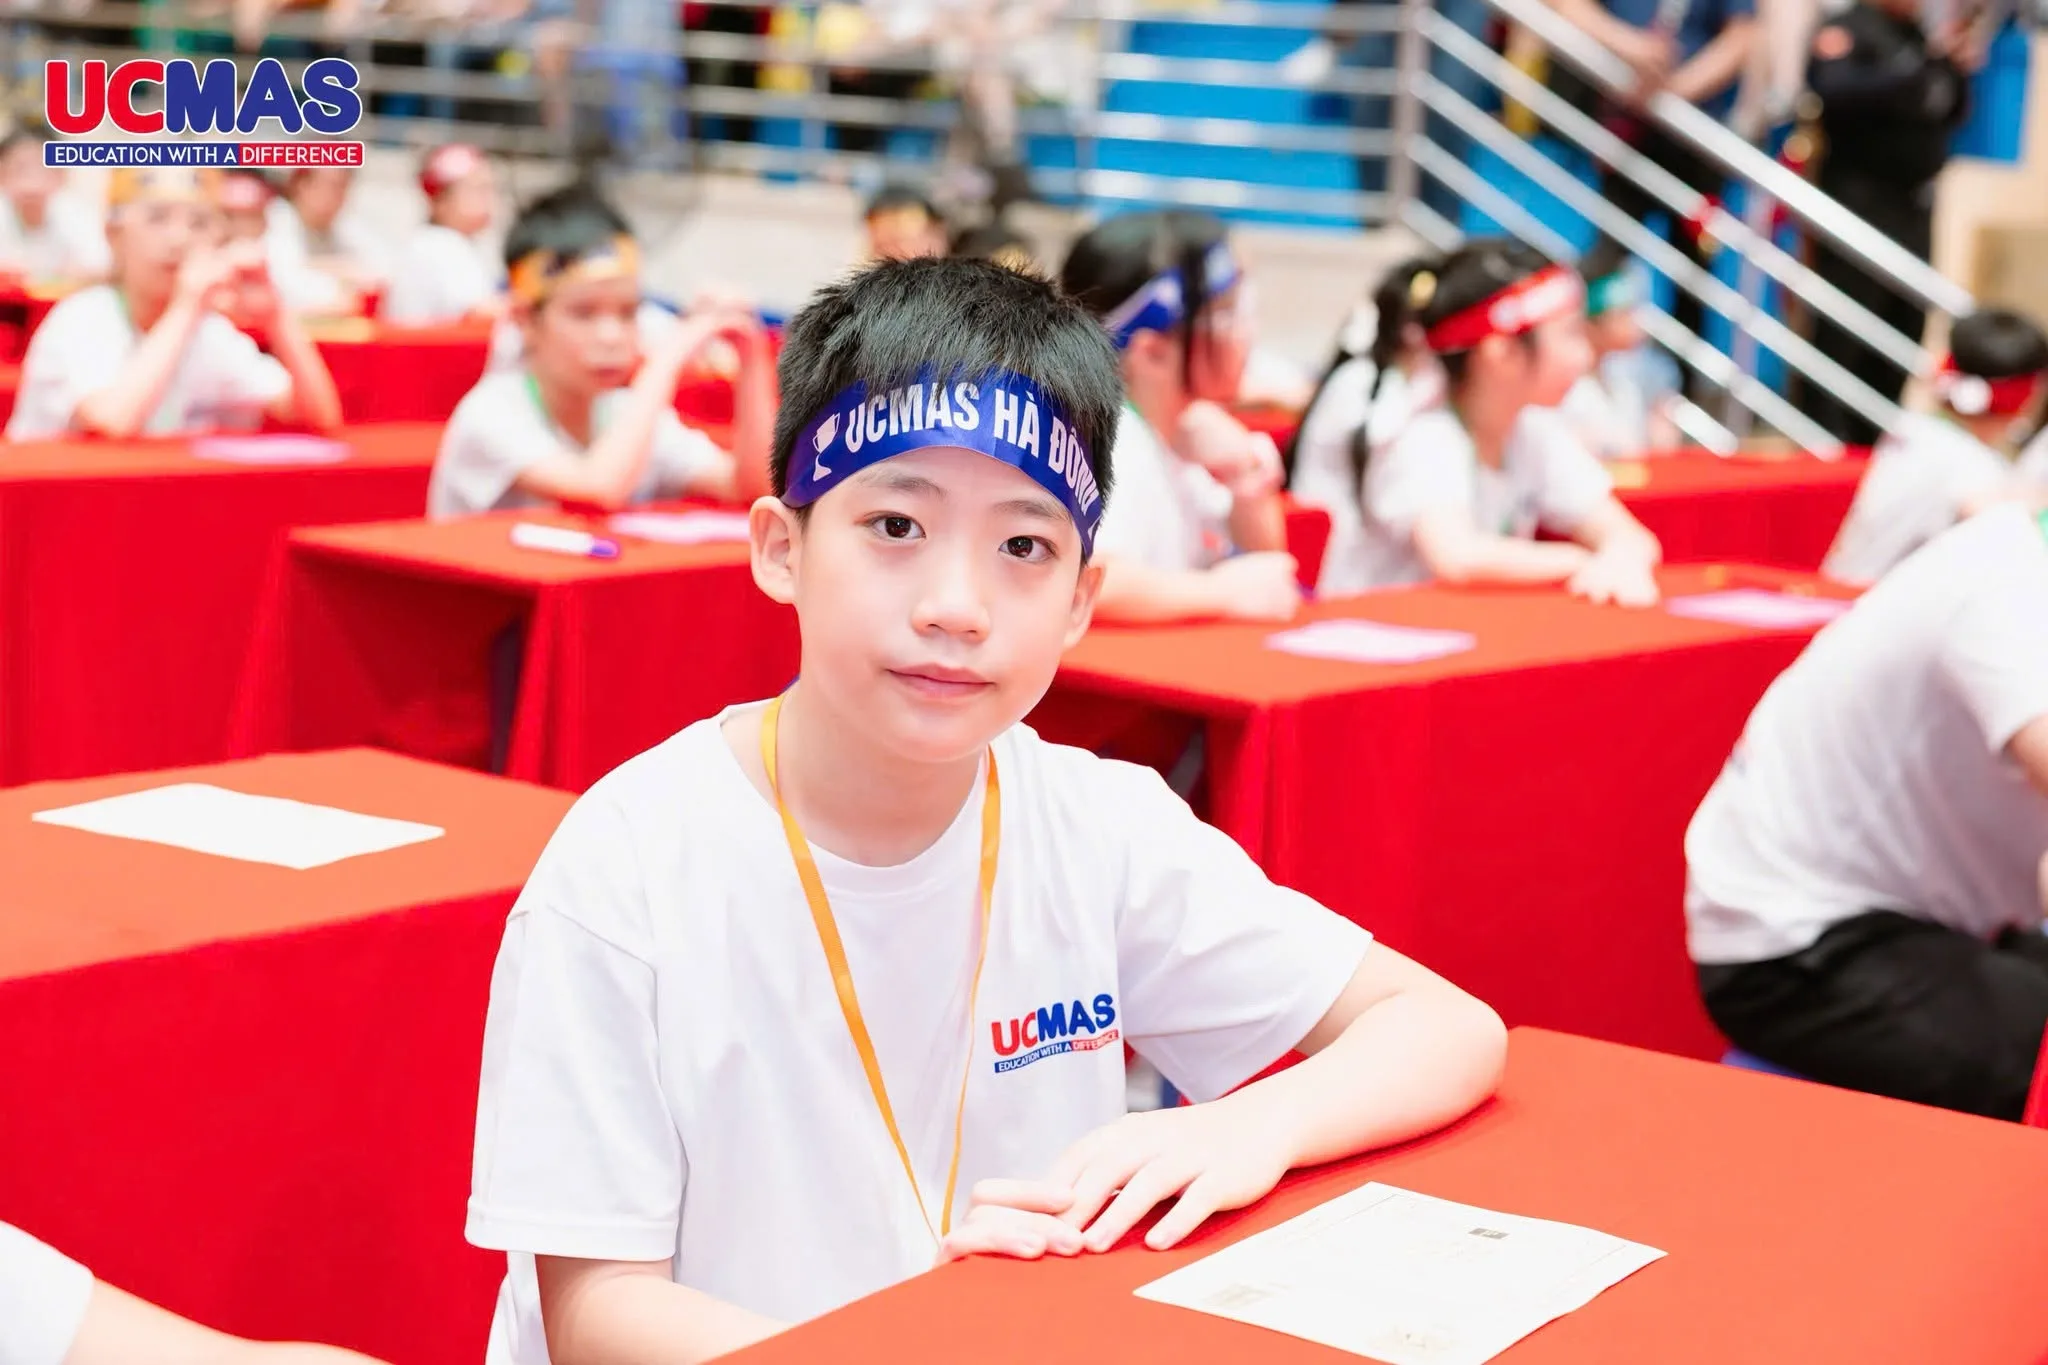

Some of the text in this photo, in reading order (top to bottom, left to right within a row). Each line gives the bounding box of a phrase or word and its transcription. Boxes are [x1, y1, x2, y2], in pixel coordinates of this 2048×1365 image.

[845, 382, 980, 453] UCMAS
[994, 389, 1040, 458] HÀ
[991, 994, 1116, 1056] UCMAS
[999, 1049, 1041, 1072] EDUCATION
[1040, 1043, 1063, 1057] WITH
[1064, 1042, 1073, 1051] A
